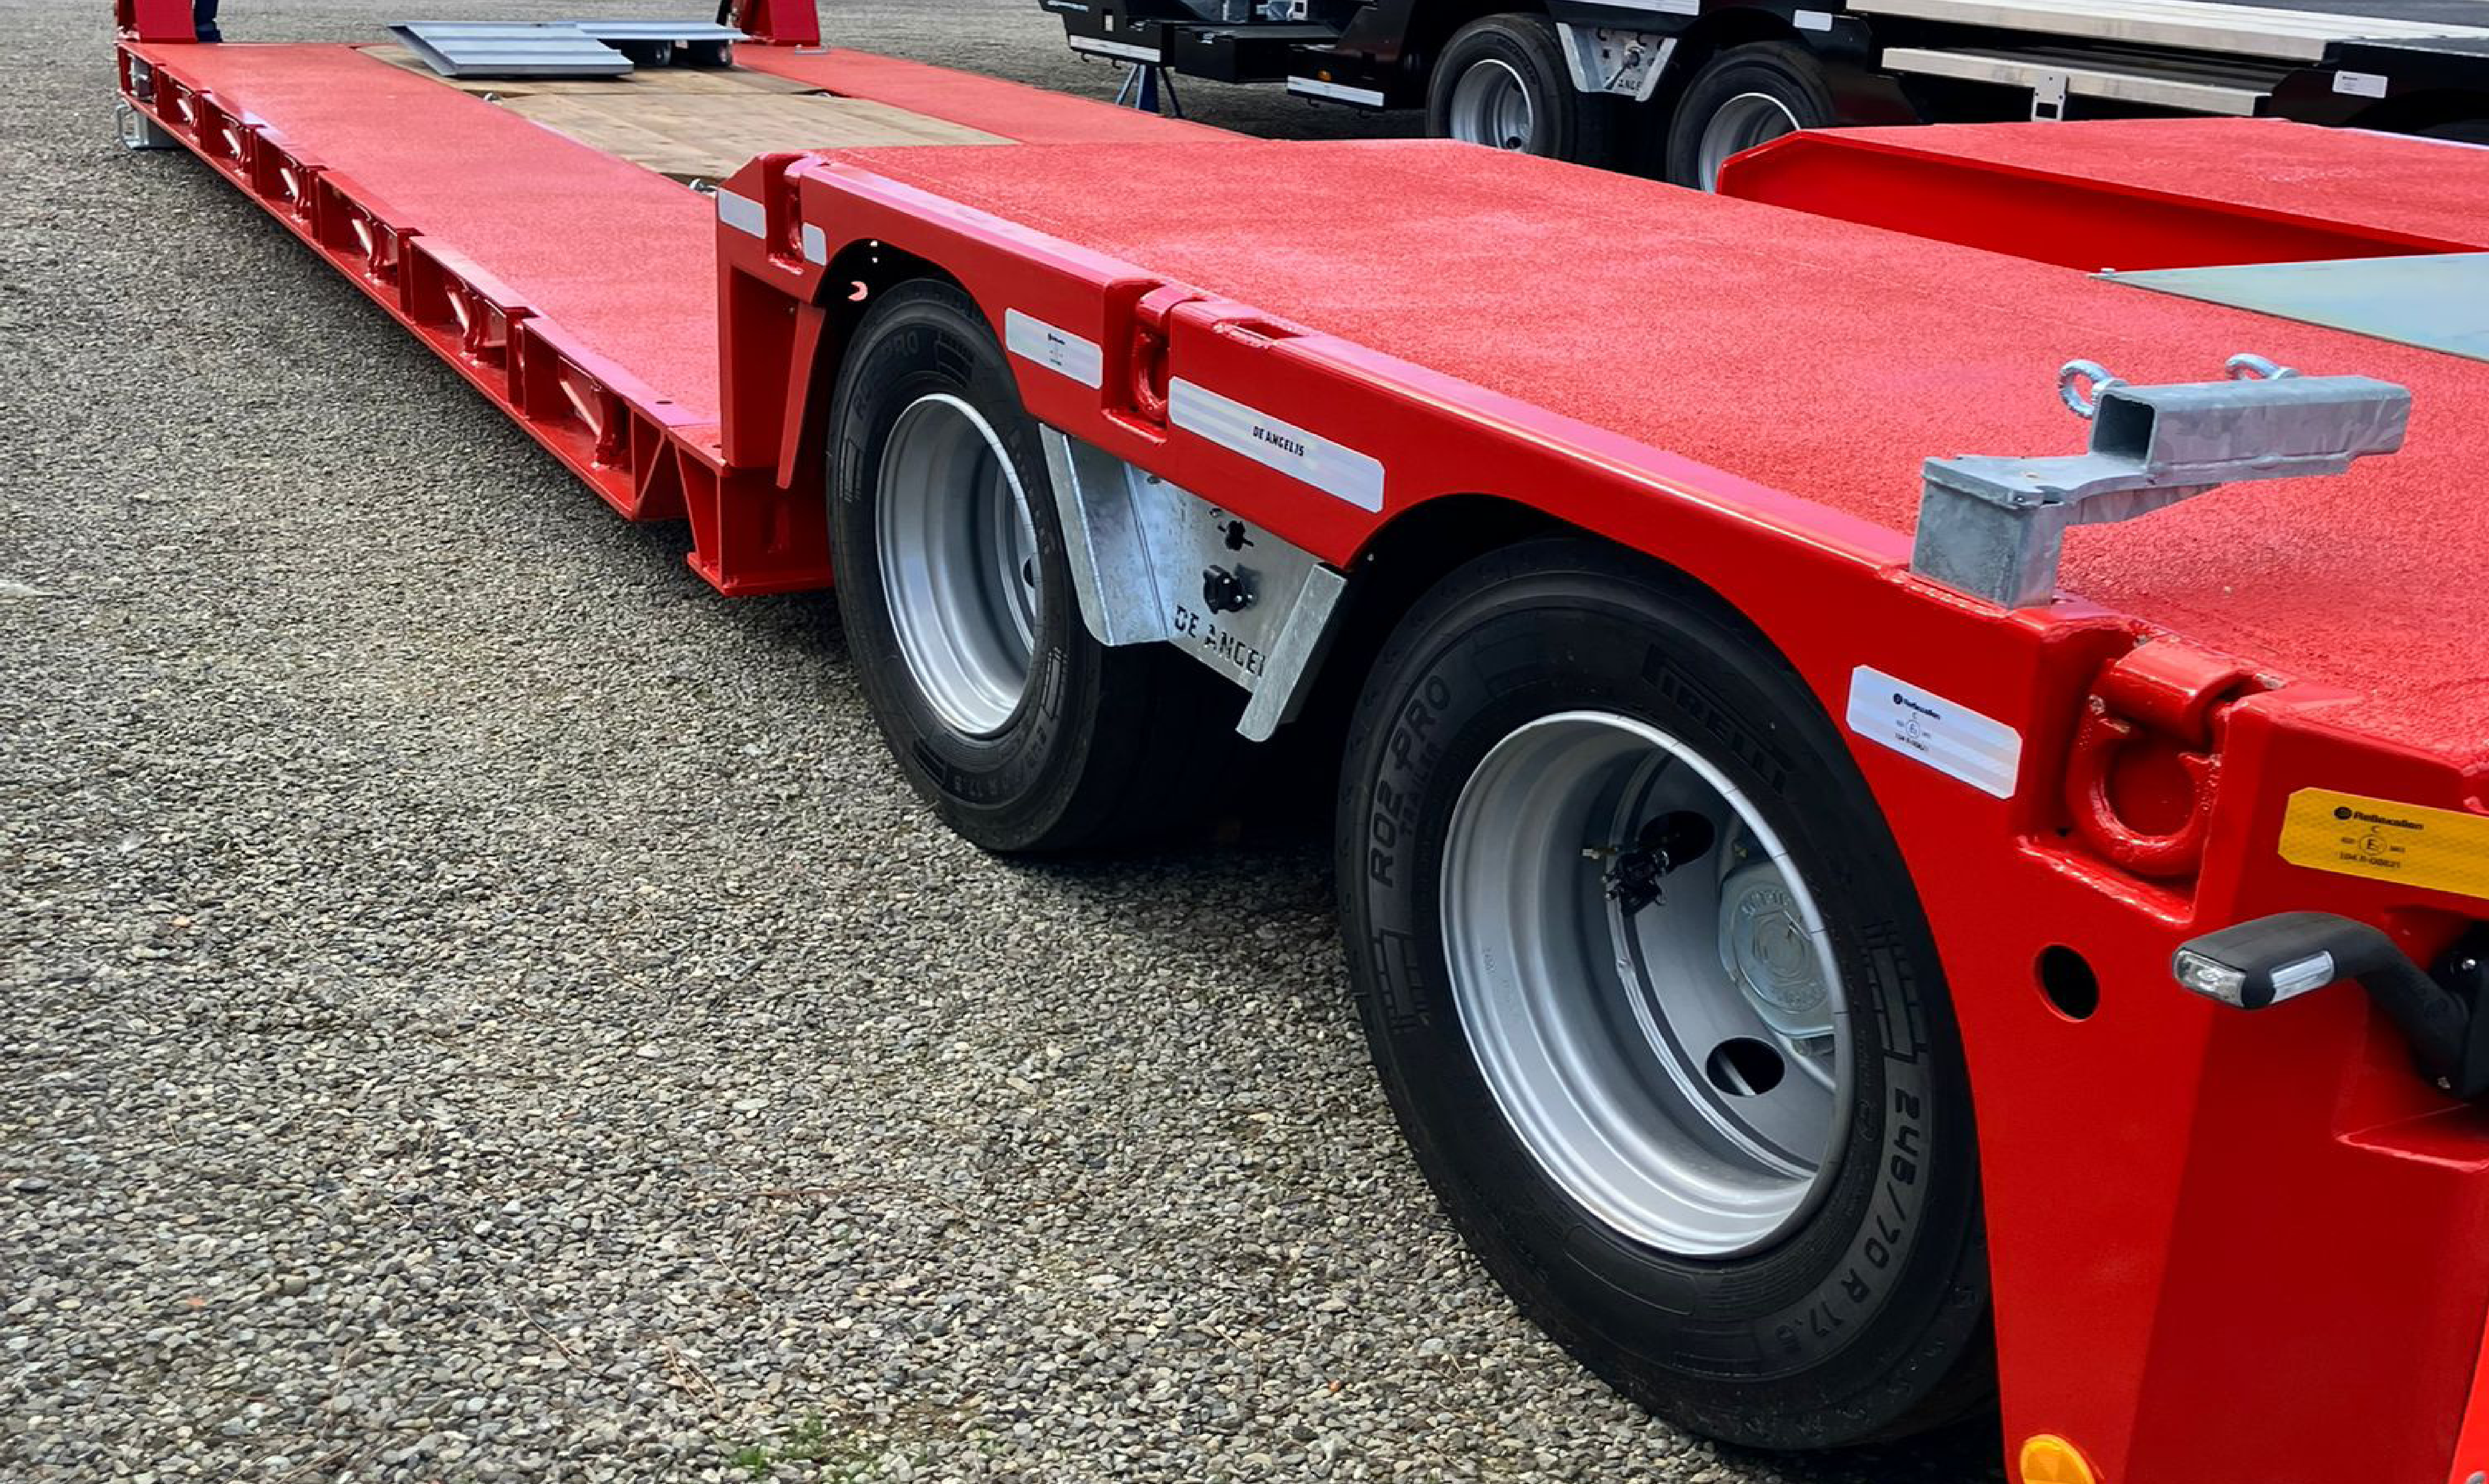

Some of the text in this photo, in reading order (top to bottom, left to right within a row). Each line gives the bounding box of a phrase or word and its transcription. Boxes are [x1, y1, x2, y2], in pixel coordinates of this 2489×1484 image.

[1175, 605, 1200, 639] DE
[1393, 674, 1451, 771] PRO
[1642, 642, 1797, 795] PIRELLI
[1864, 1087, 1920, 1268] 245/70
[1841, 1268, 1870, 1303] R
